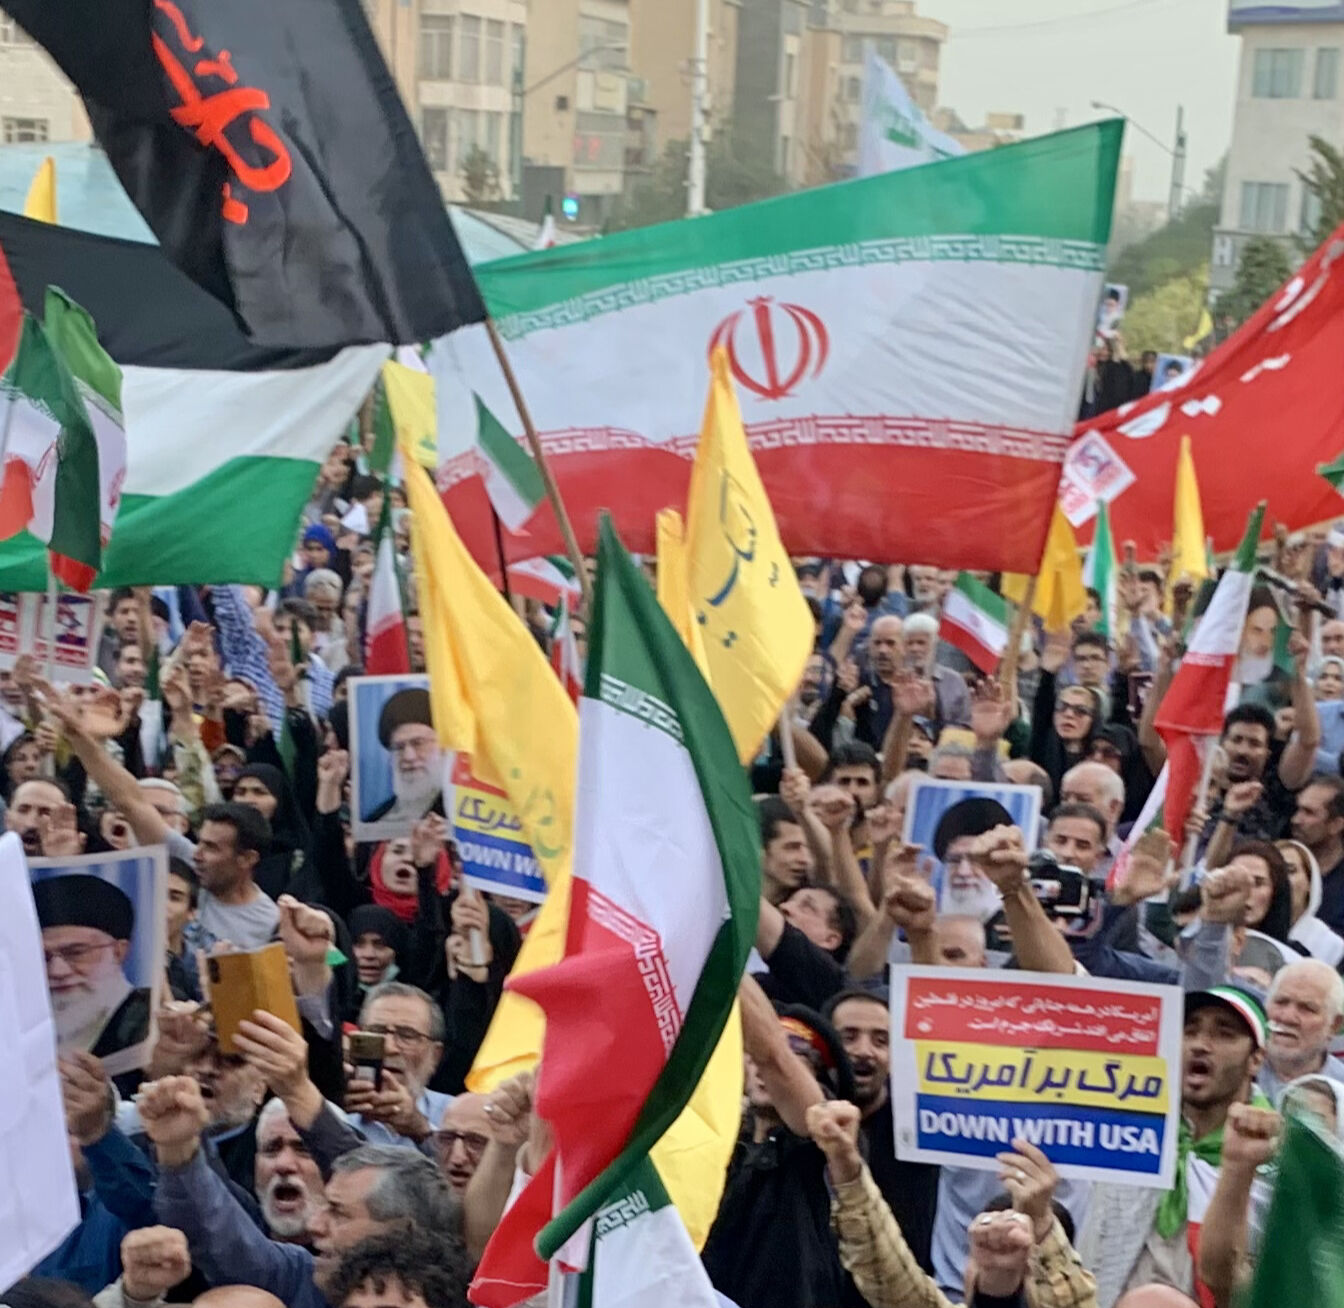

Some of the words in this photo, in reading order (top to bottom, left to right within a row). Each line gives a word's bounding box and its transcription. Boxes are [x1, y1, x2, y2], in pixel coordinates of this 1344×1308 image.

[924, 1049, 1038, 1094] آمریکا
[1034, 1066, 1072, 1099] بر
[1075, 1058, 1163, 1101] مرگ
[918, 1108, 1009, 1144] DOWN
[1011, 1116, 1096, 1149] WITH
[1098, 1123, 1161, 1156] USA
